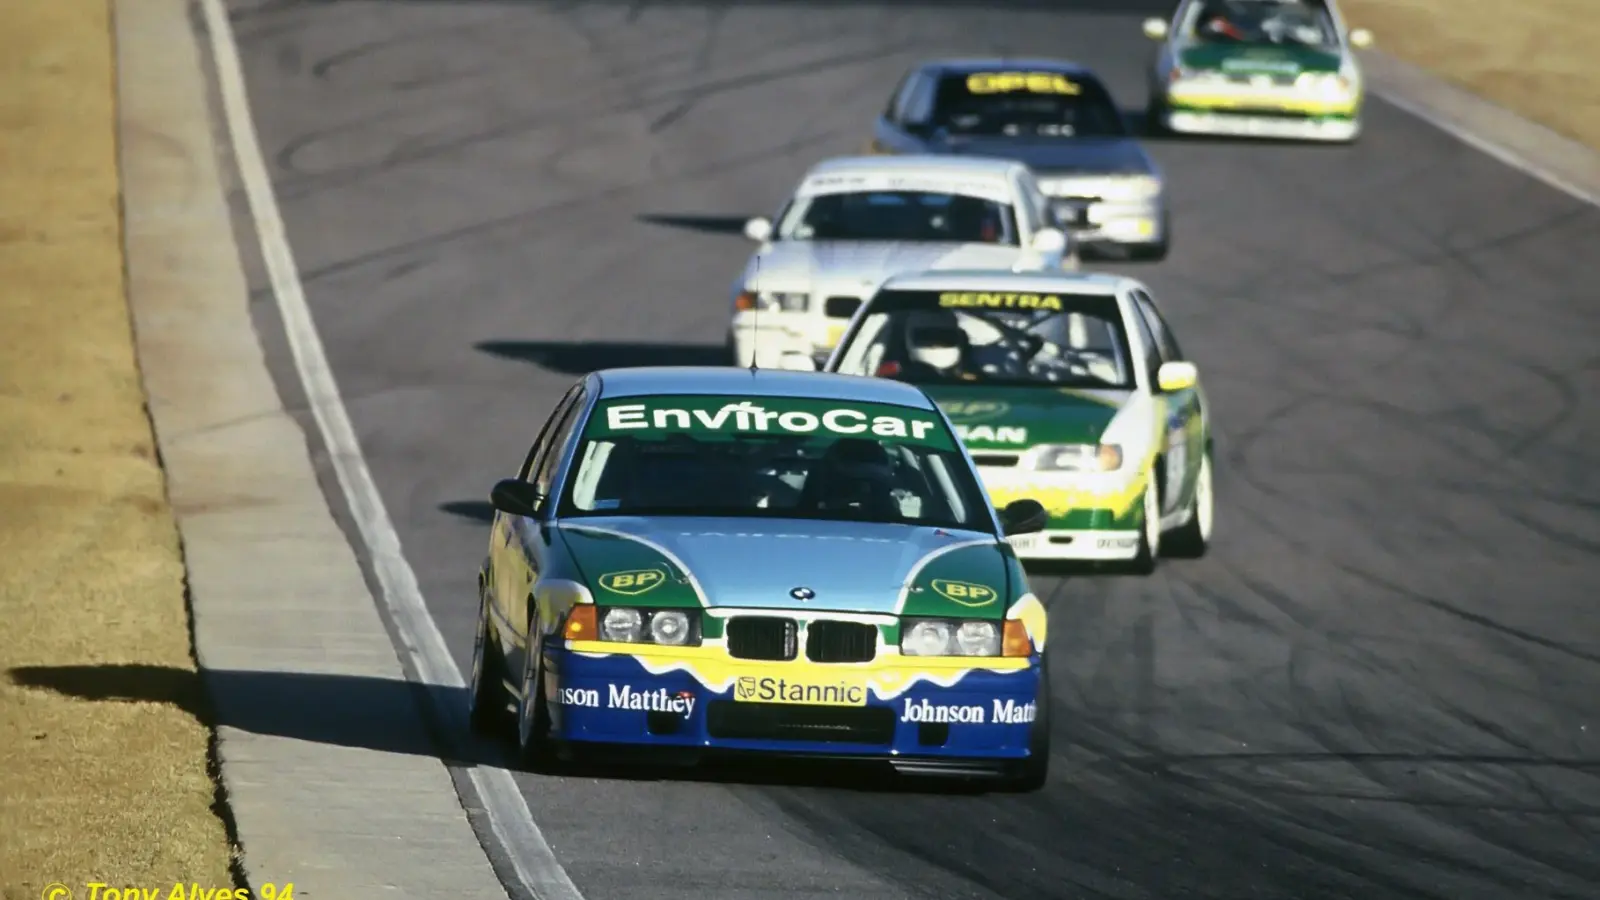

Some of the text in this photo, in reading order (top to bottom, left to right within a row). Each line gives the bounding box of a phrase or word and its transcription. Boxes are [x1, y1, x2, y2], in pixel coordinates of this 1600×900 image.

[967, 73, 1081, 95] OPEL
[939, 292, 1061, 311] SENTRA
[607, 402, 935, 439] EnviroCar
[612, 573, 658, 587] BP
[946, 584, 990, 598] BP
[555, 683, 695, 720] nson Matthey
[758, 678, 862, 703] Stannic
[900, 698, 1038, 723] Johnson Matt
